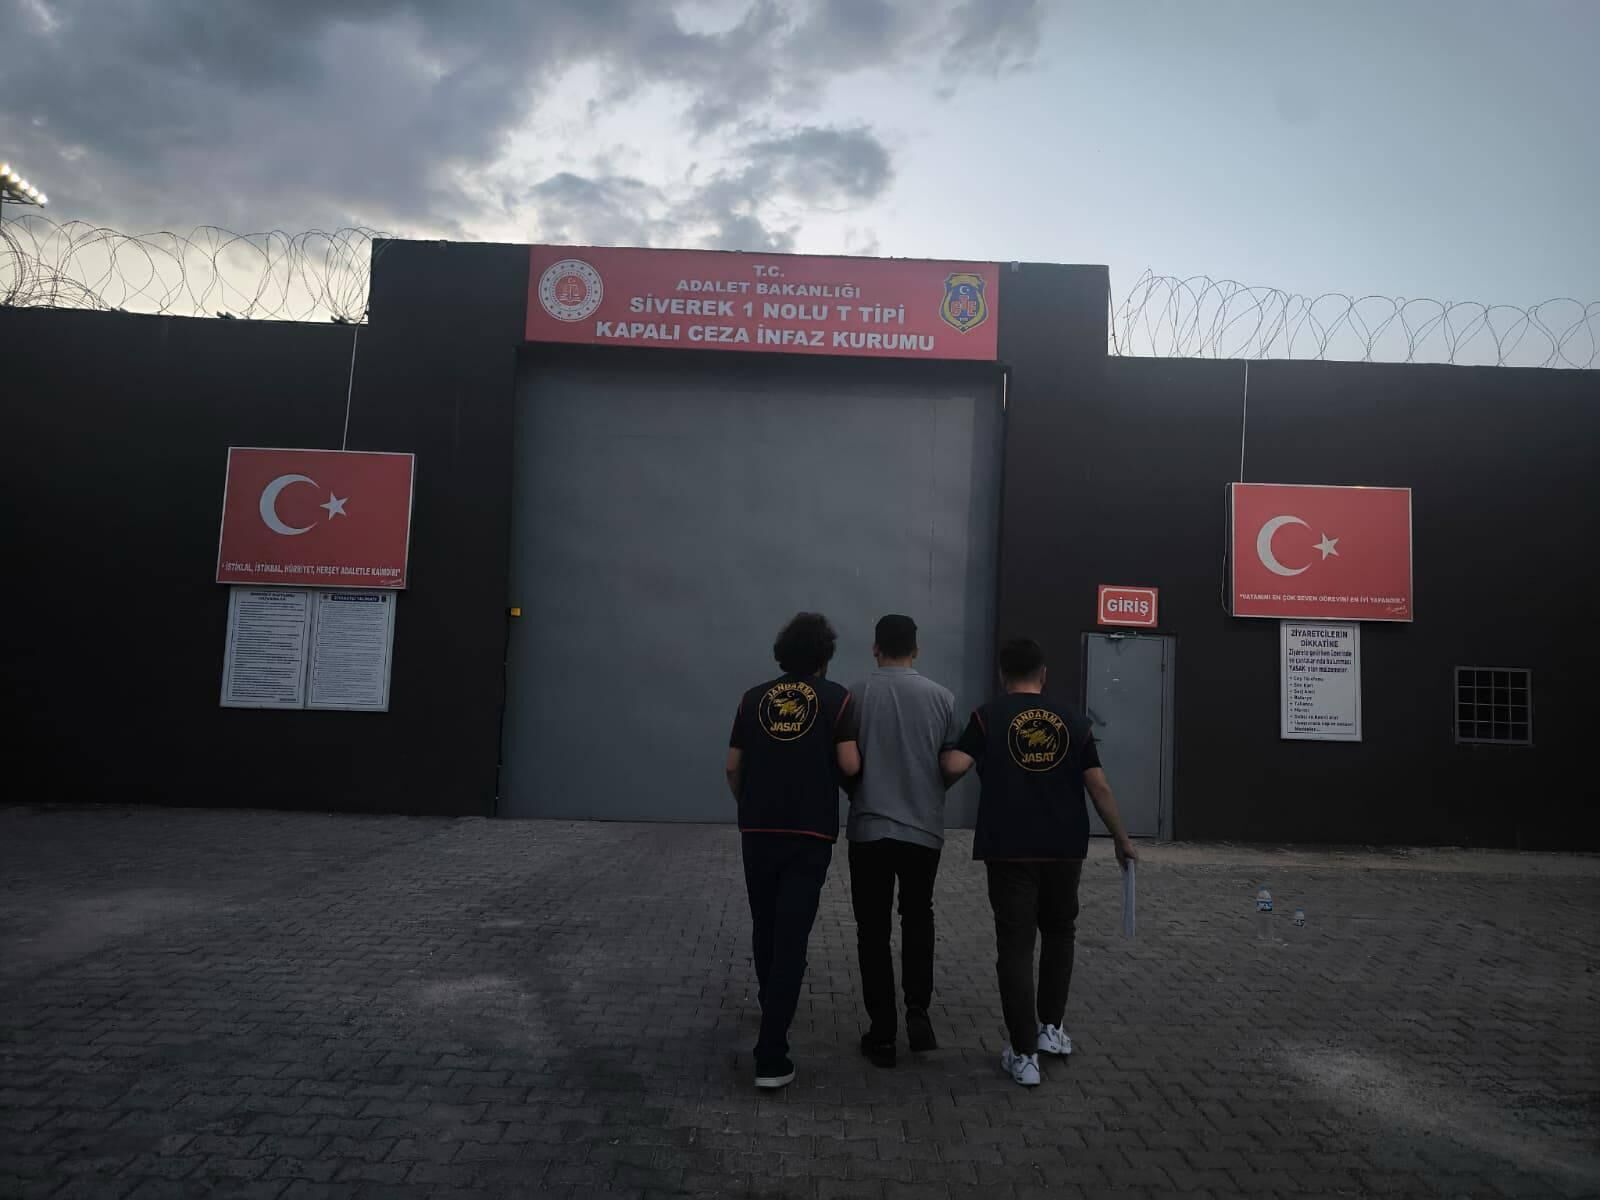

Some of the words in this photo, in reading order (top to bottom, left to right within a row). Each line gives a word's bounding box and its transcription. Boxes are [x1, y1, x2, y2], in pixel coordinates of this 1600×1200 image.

[753, 265, 785, 278] T.C.
[676, 279, 750, 293] ADALET
[756, 282, 861, 299] BAKANLIĞI
[630, 293, 734, 316] SİVEREK
[743, 301, 753, 318] 1
[763, 303, 828, 321] NOLU
[837, 306, 852, 321] T
[859, 303, 905, 324] TİPİ
[596, 321, 681, 341] KAPALI
[688, 325, 750, 343] CEZA
[757, 324, 825, 347] İNFAZ
[832, 331, 935, 351] KURUMU
[340, 567, 371, 576] ADALETLE
[1107, 597, 1149, 616] GİRİŞ
[768, 682, 815, 701] JANDARMA
[770, 721, 803, 732] JASAT
[1013, 711, 1063, 731] JANDARMA
[1022, 751, 1056, 763] JASAT
